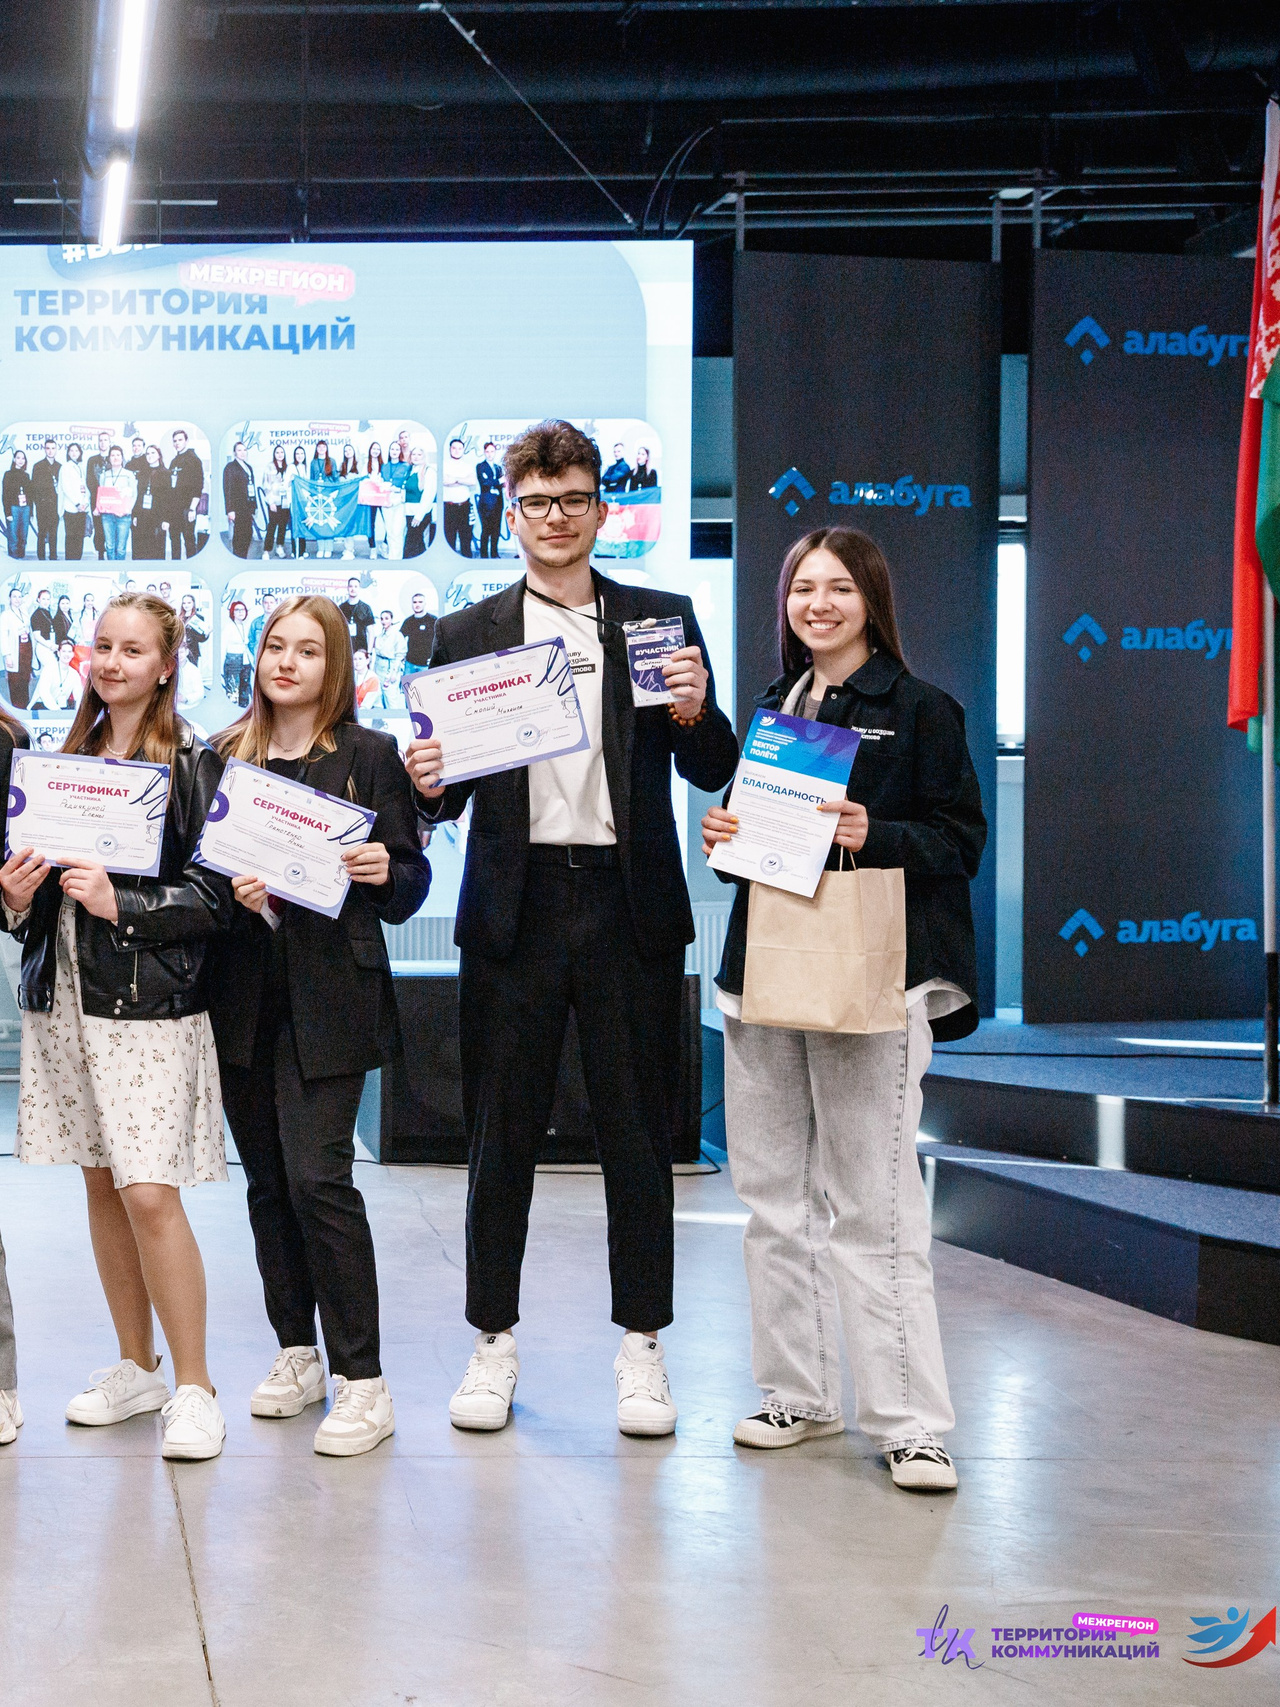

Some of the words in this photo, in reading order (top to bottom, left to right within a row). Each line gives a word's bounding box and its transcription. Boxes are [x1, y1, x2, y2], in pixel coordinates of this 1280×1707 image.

[189, 263, 346, 292] МЕЖРЕГИОН
[14, 287, 268, 317] ТЕРРИТОРИЯ
[14, 317, 356, 355] КОММУНИКАЦИЙ
[829, 475, 972, 516] алабуга
[447, 673, 533, 703] СЕРТИФИКАТ
[474, 692, 507, 704] УЧАСТНИКА
[750, 748, 778, 760] ПОЛЁТА
[752, 740, 780, 751] ВЕКТОР
[47, 781, 130, 798] СЕРТИФИКАТ
[69, 794, 102, 802] УЧАСТНИКА
[742, 776, 827, 805] БЛАГОДАРНОСТЬ
[253, 797, 332, 833] СЕРТИФИКАТ
[271, 815, 301, 830] УЧАСТНИКА
[1116, 911, 1260, 952] алабуга
